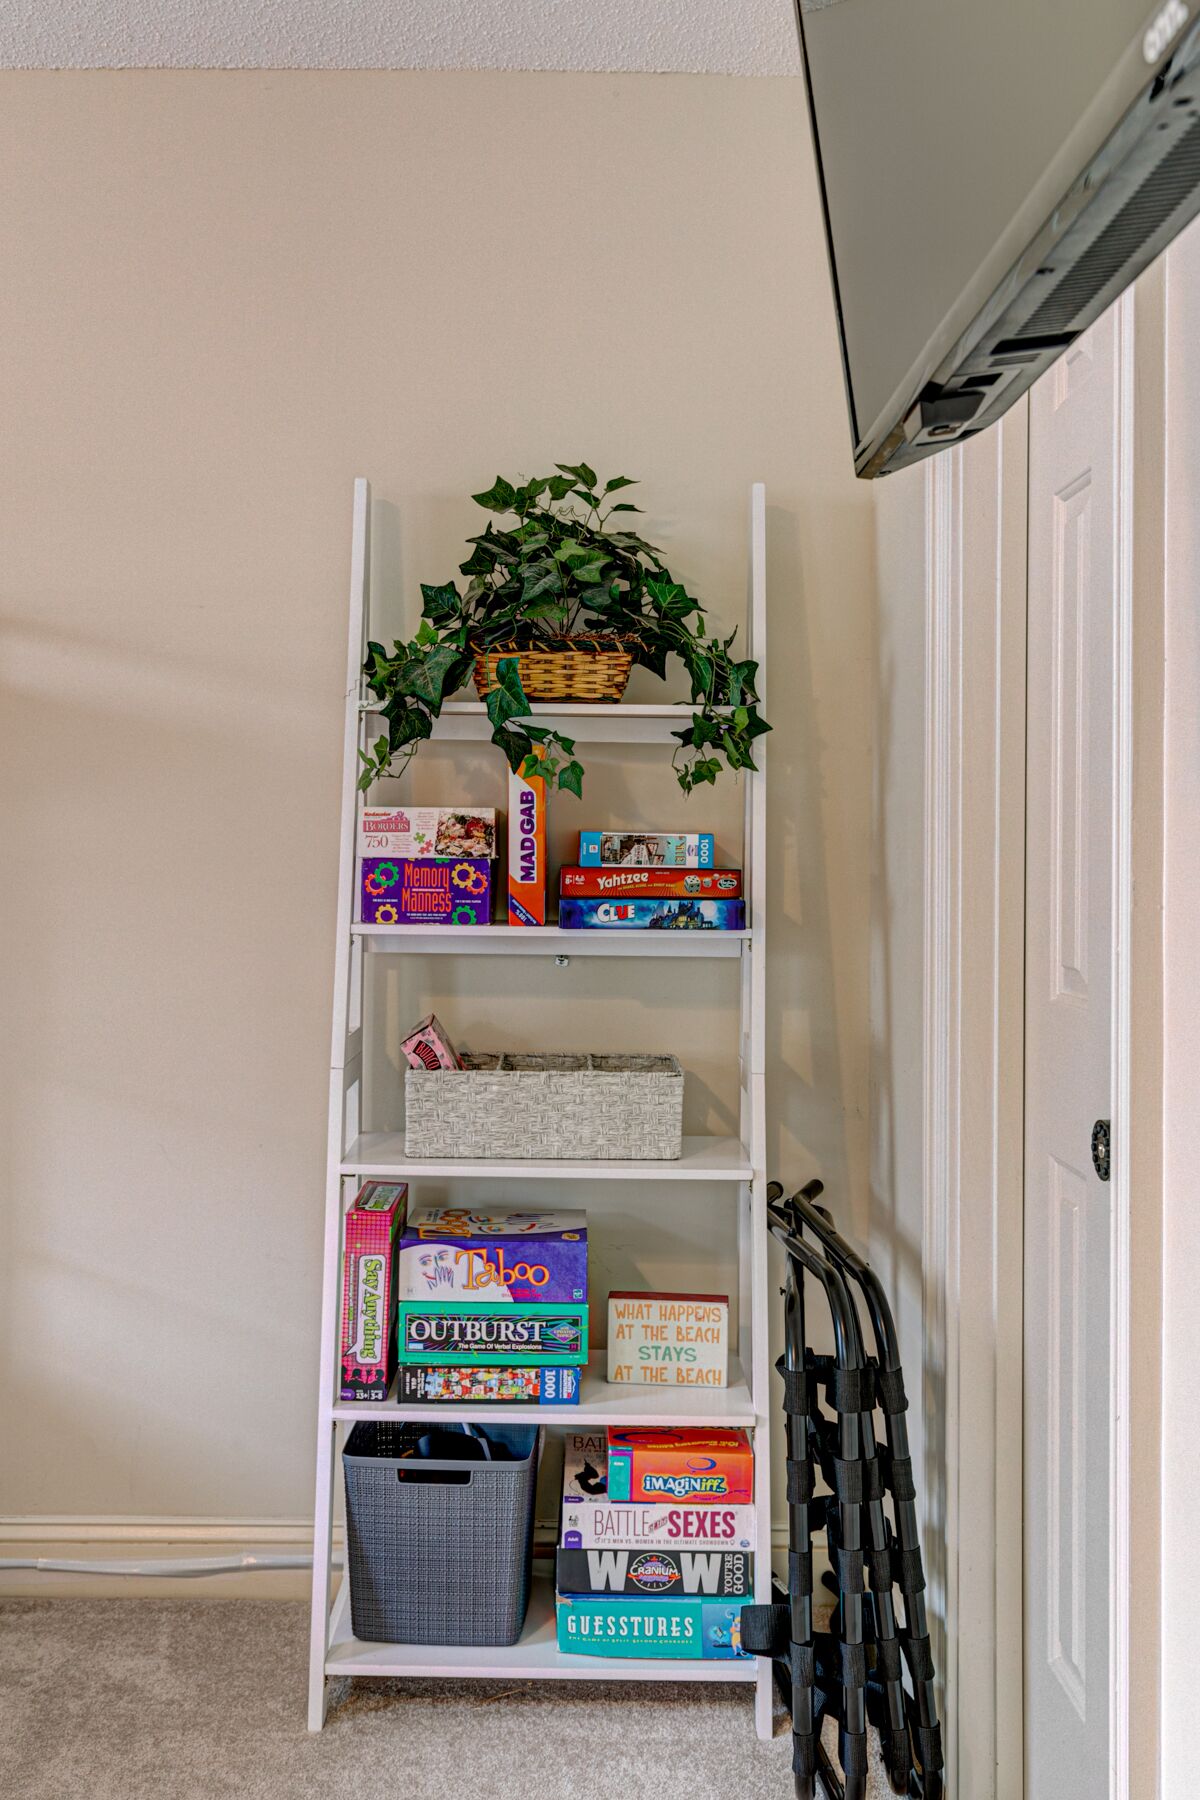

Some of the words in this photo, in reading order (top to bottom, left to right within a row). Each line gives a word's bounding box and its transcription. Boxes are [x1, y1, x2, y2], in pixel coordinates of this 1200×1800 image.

[365, 835, 389, 848] 750
[700, 839, 709, 864] 1000
[404, 863, 450, 892] Memory
[597, 873, 648, 890] Yahtzee
[597, 903, 635, 922] CLUE
[362, 1259, 382, 1290] Say
[455, 1248, 549, 1290] Taboo
[360, 1289, 382, 1359] Anything
[615, 1303, 652, 1319] WHAT
[659, 1305, 722, 1323] HAPPENS
[410, 1320, 546, 1342] OUTBURST
[616, 1324, 634, 1339] AT
[642, 1324, 668, 1341] THE
[676, 1325, 720, 1343] BEACH
[638, 1346, 697, 1362] STAYS
[545, 1369, 556, 1398] 1000
[614, 1365, 633, 1380] AT
[640, 1366, 668, 1382] THE
[676, 1367, 721, 1385] BEACH
[594, 1510, 649, 1536] BATTLE
[668, 1510, 736, 1538] SEXES
[724, 1554, 733, 1594] YOU'RE
[733, 1554, 744, 1595] GOOD
[567, 1615, 693, 1637] GUESSTURES
